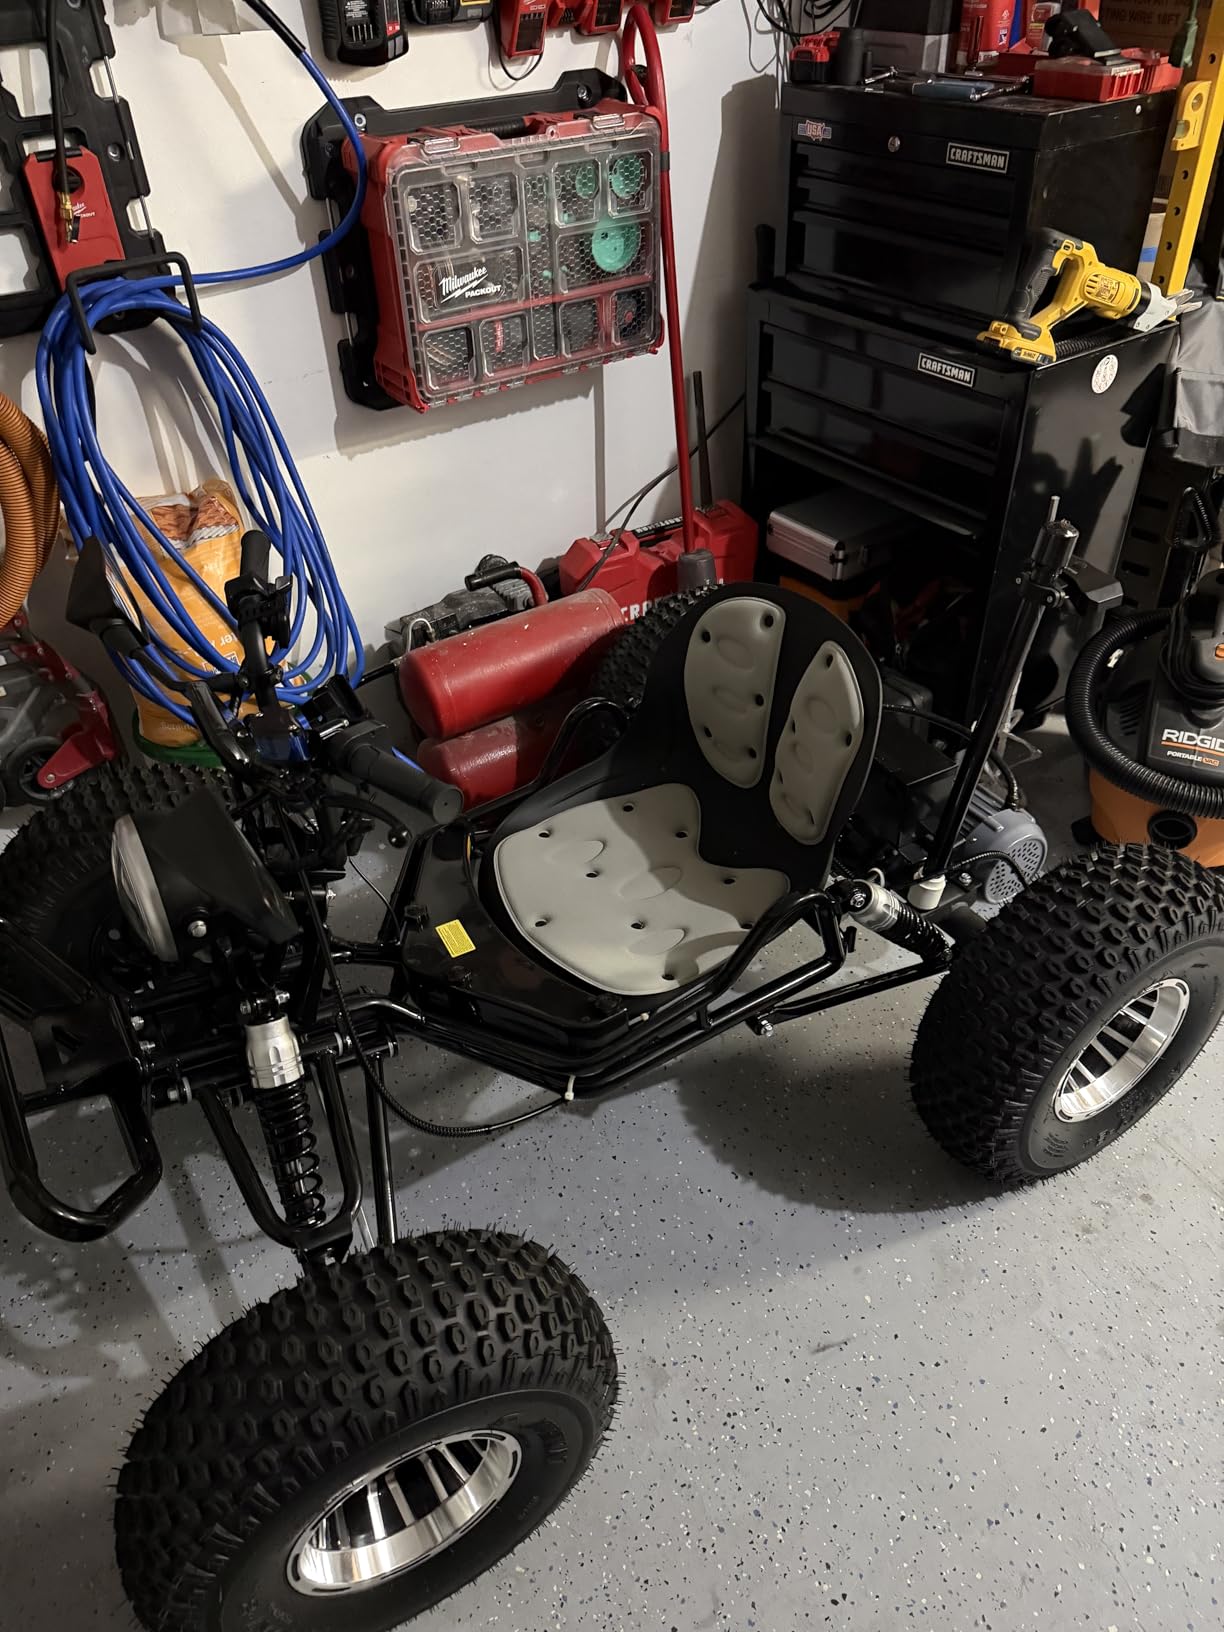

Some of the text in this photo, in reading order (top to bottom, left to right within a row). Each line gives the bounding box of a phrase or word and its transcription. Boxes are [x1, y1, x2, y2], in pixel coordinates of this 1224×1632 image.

[806, 123, 822, 136] USA
[949, 147, 1006, 169] CRAFTSMAN
[439, 266, 488, 297] Milwaukee
[464, 284, 502, 298] PACKOUT
[920, 357, 971, 382] CRAFTSMAN
[1162, 728, 1224, 751] RIDGID
[1167, 750, 1202, 761] PORTABLE
